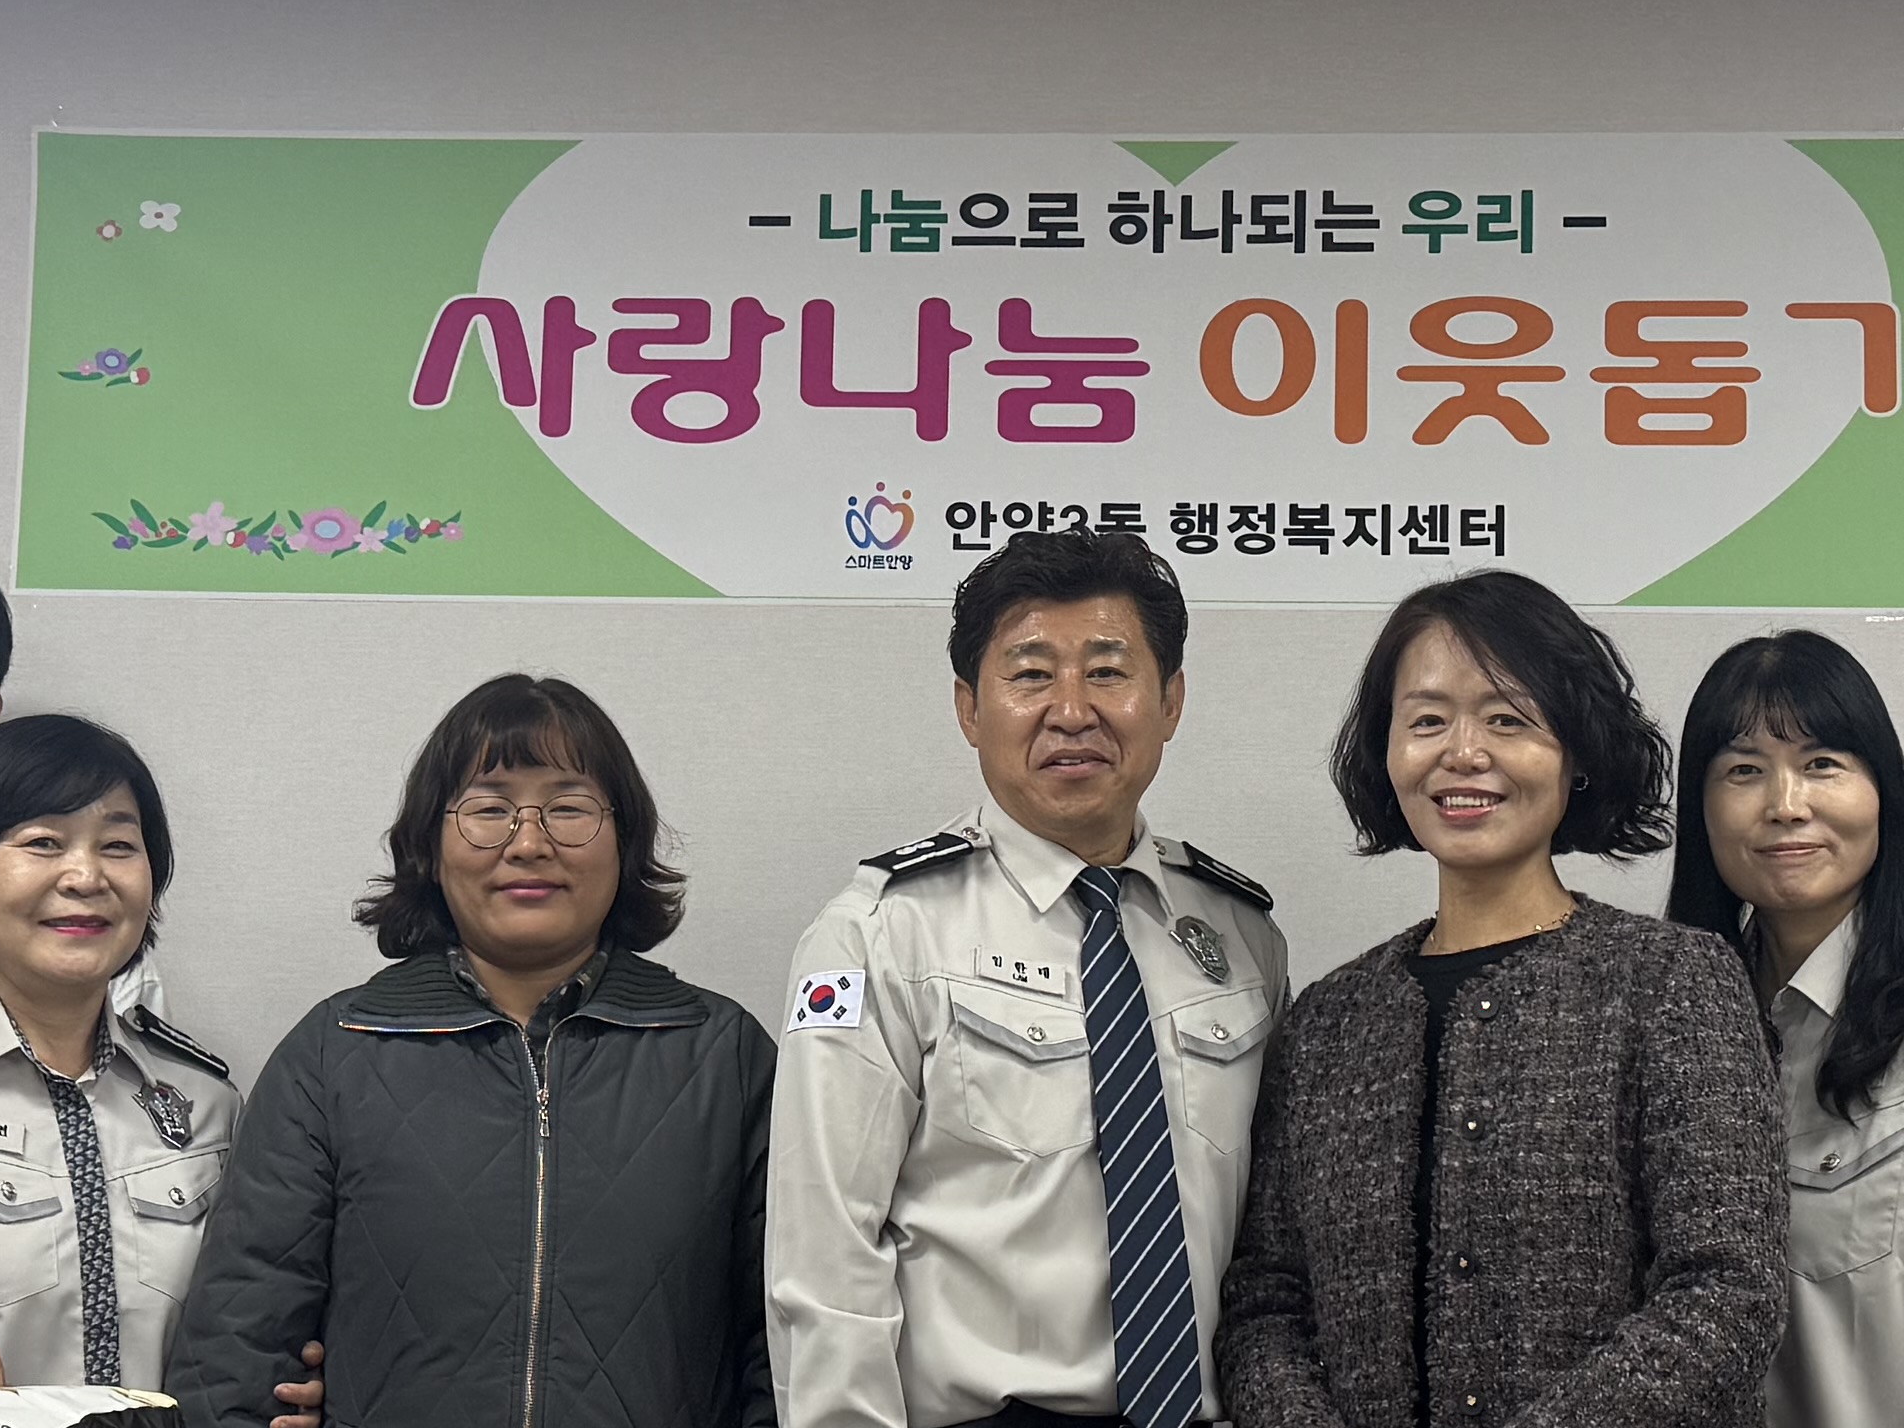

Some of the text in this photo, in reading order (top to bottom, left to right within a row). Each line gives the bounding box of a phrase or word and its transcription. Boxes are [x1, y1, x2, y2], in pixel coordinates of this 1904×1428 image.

[818, 186, 1534, 254] 나눔으로 하나되는 우리
[414, 296, 1148, 443] 사랑나눔
[1169, 500, 1507, 556] 행정복지센터
[845, 554, 914, 570] 스마트안양
